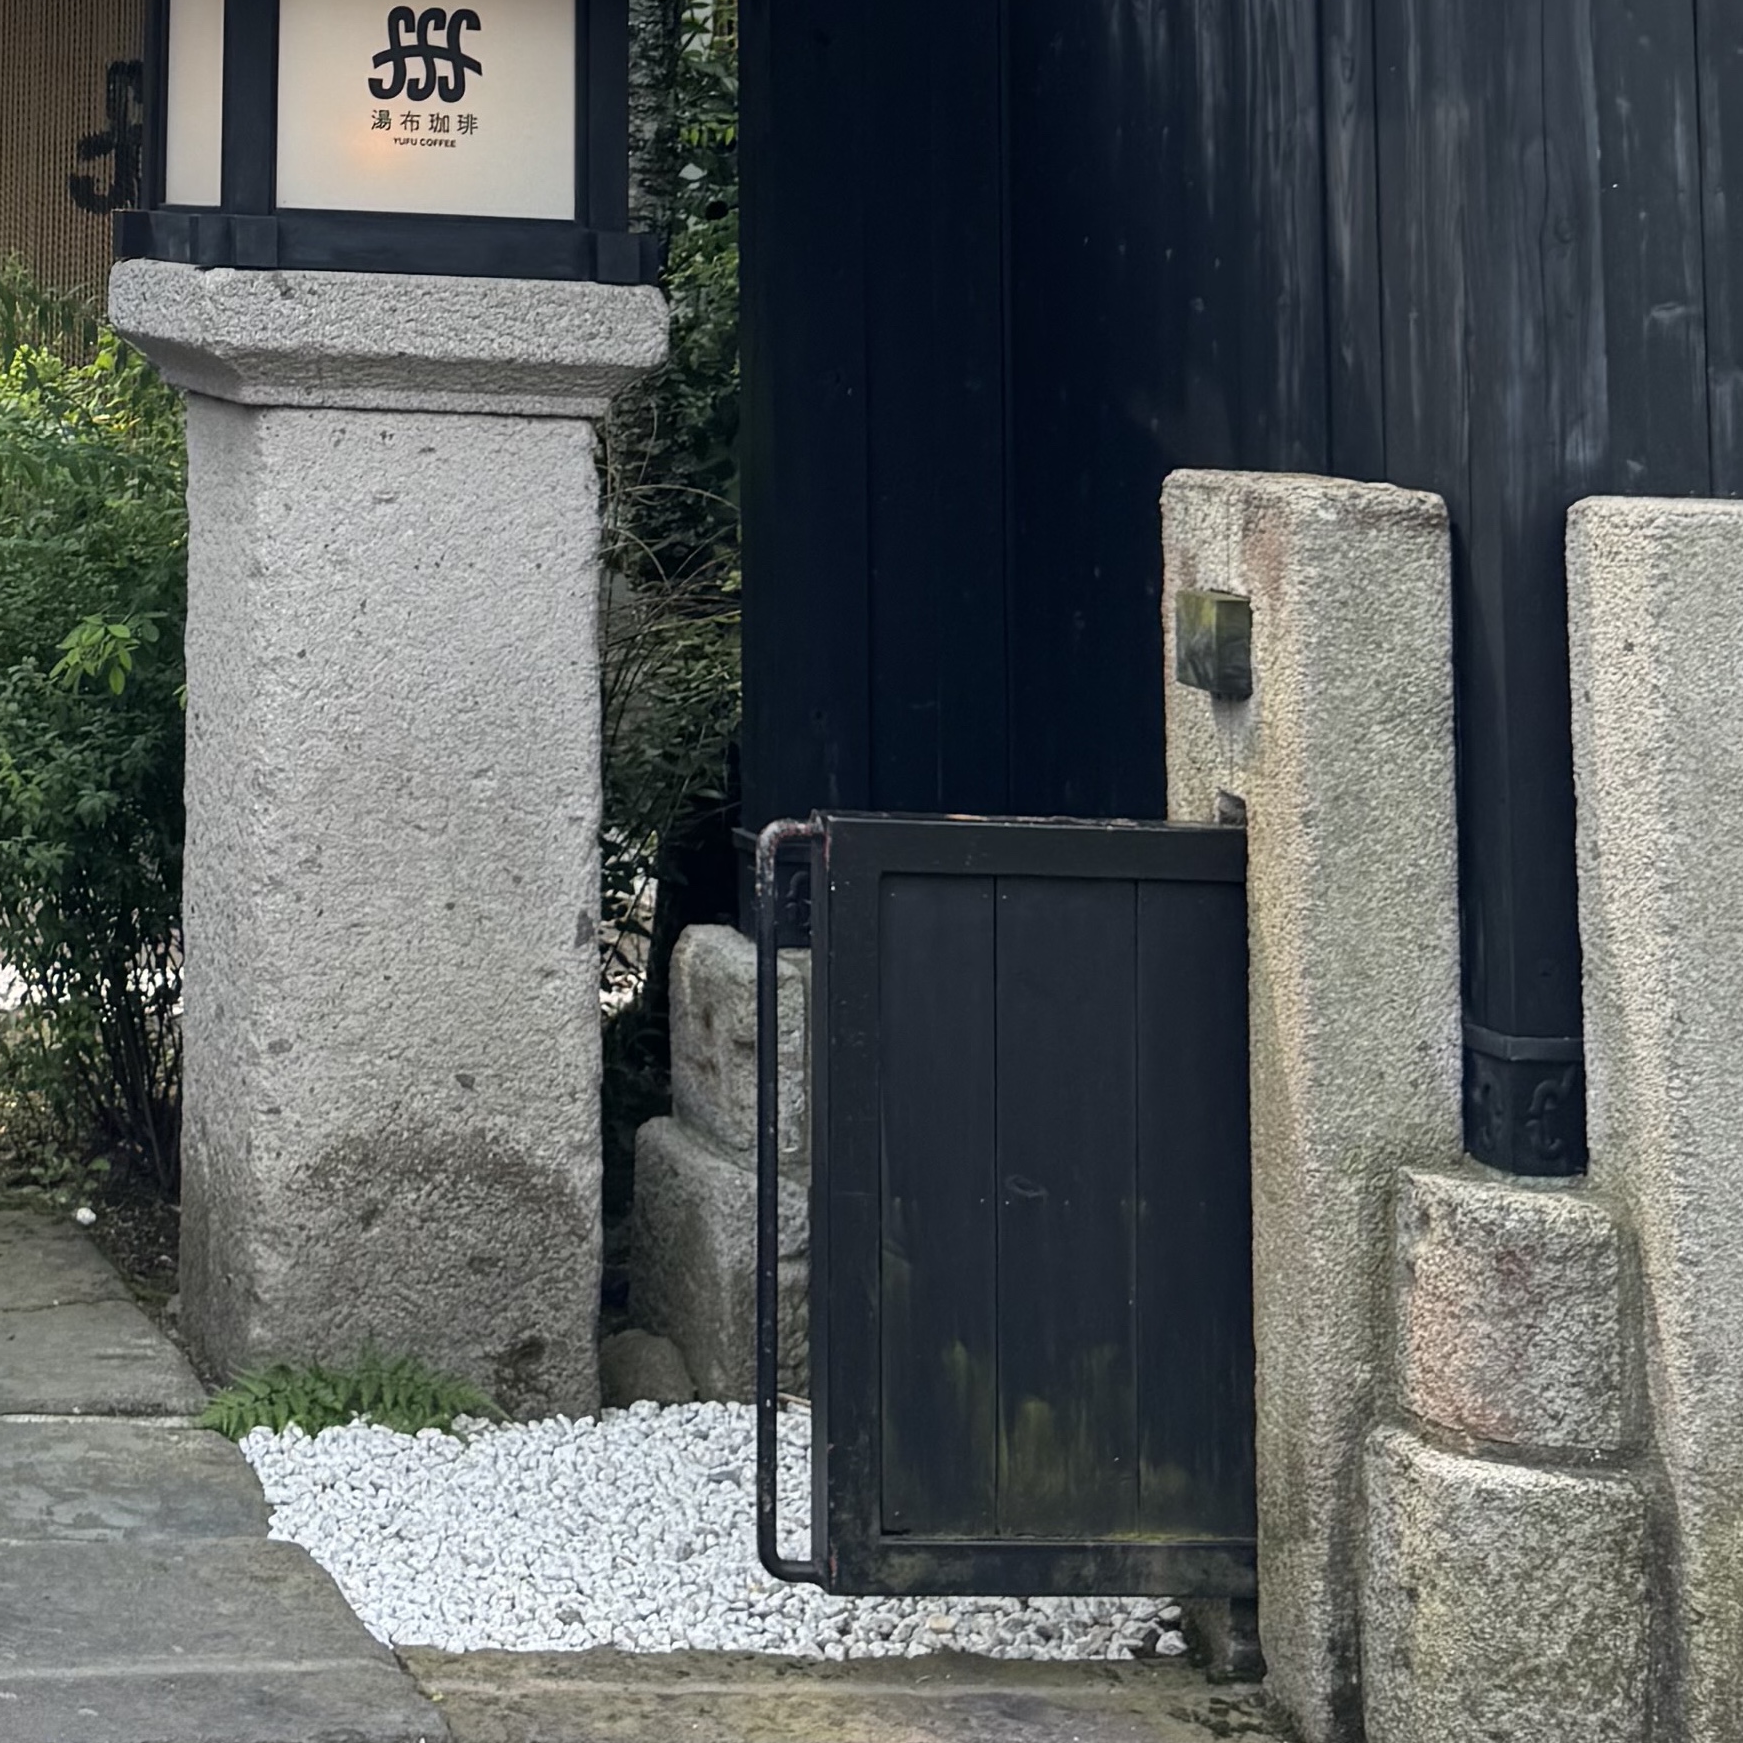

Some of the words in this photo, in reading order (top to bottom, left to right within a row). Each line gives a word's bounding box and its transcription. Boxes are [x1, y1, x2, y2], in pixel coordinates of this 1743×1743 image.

[370, 109, 479, 135] 湯布珈琲
[393, 137, 418, 146] YUFU
[419, 138, 457, 148] COFFEE
